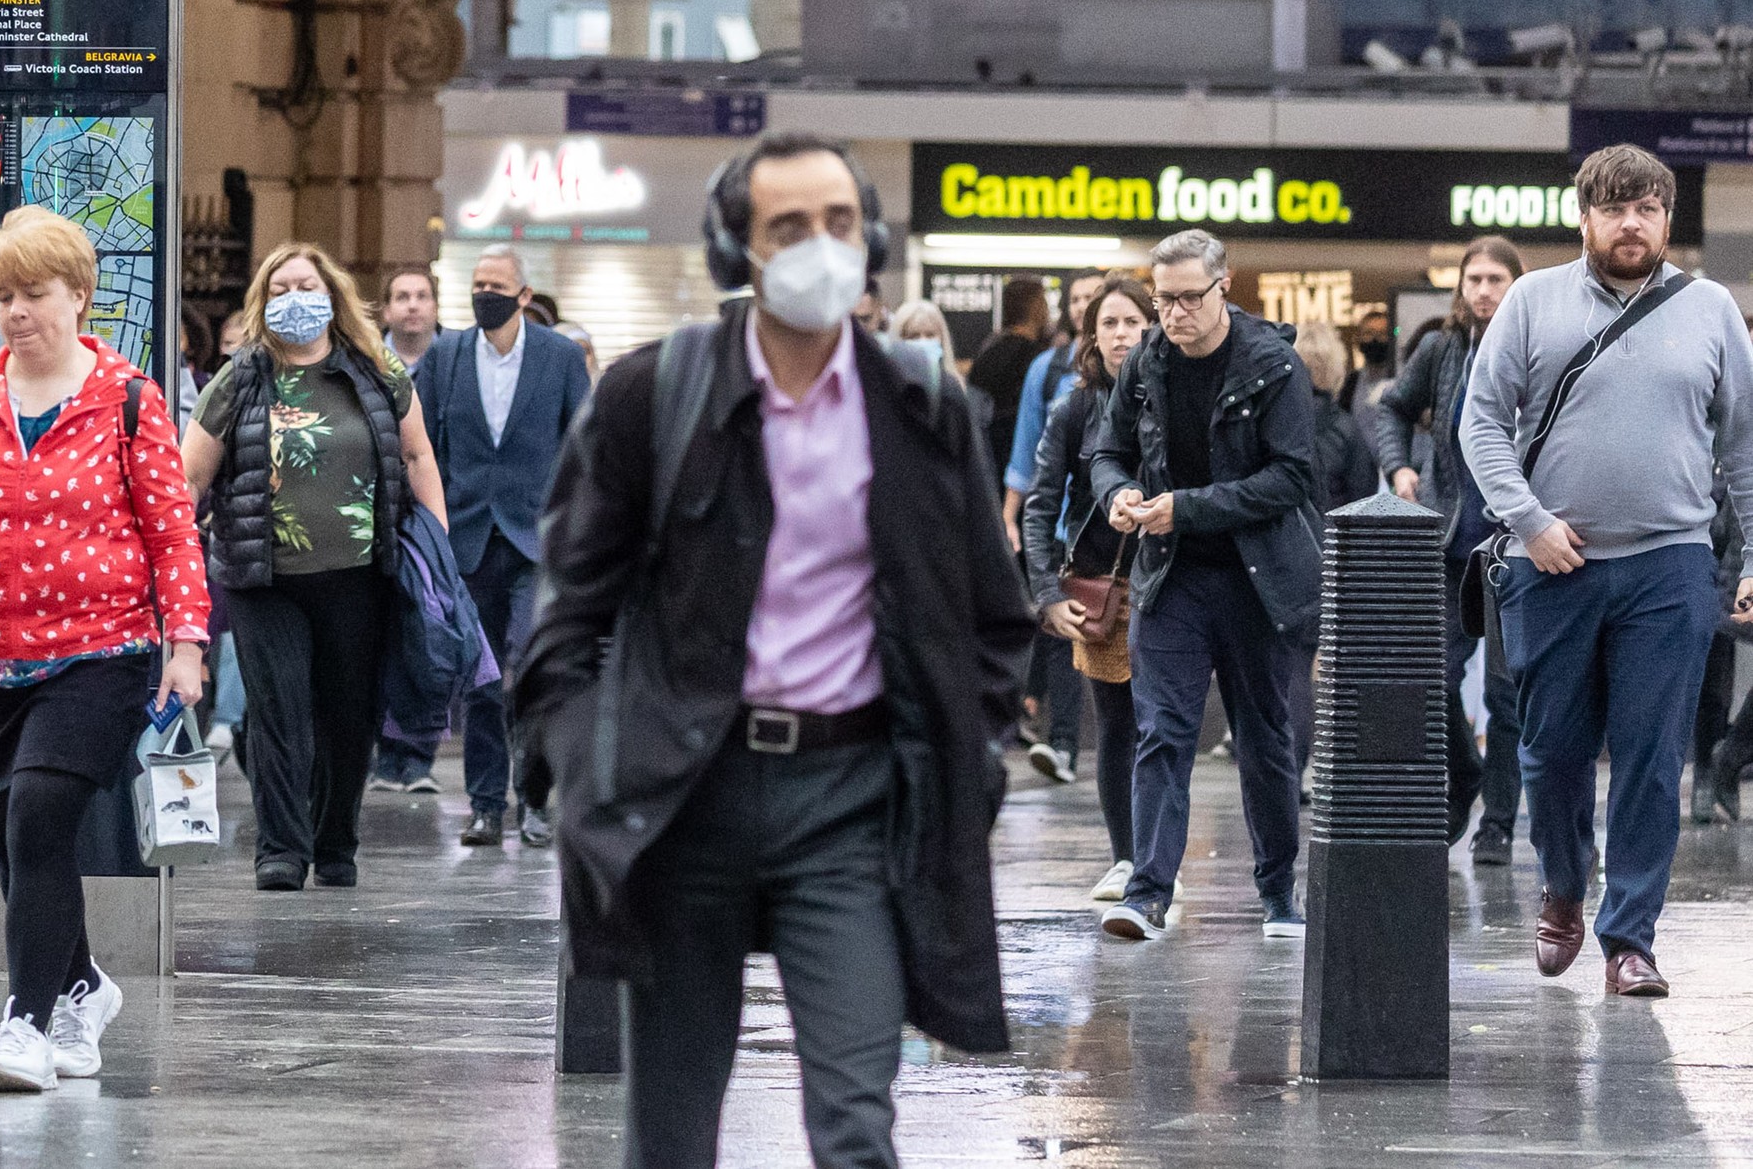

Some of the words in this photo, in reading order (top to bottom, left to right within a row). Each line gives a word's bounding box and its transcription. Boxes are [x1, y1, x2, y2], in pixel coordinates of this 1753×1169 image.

[12, 7, 44, 17] Street
[14, 19, 42, 29] Place
[37, 32, 88, 42] Cathedral
[85, 52, 143, 61] BELGRAVIA
[25, 64, 66, 74] Victoria
[69, 64, 102, 74] Coach
[104, 64, 143, 74] Station
[941, 162, 1154, 220] Camden
[1157, 165, 1275, 223] food
[1277, 179, 1352, 224] co.
[1450, 185, 1545, 228] FOOD
